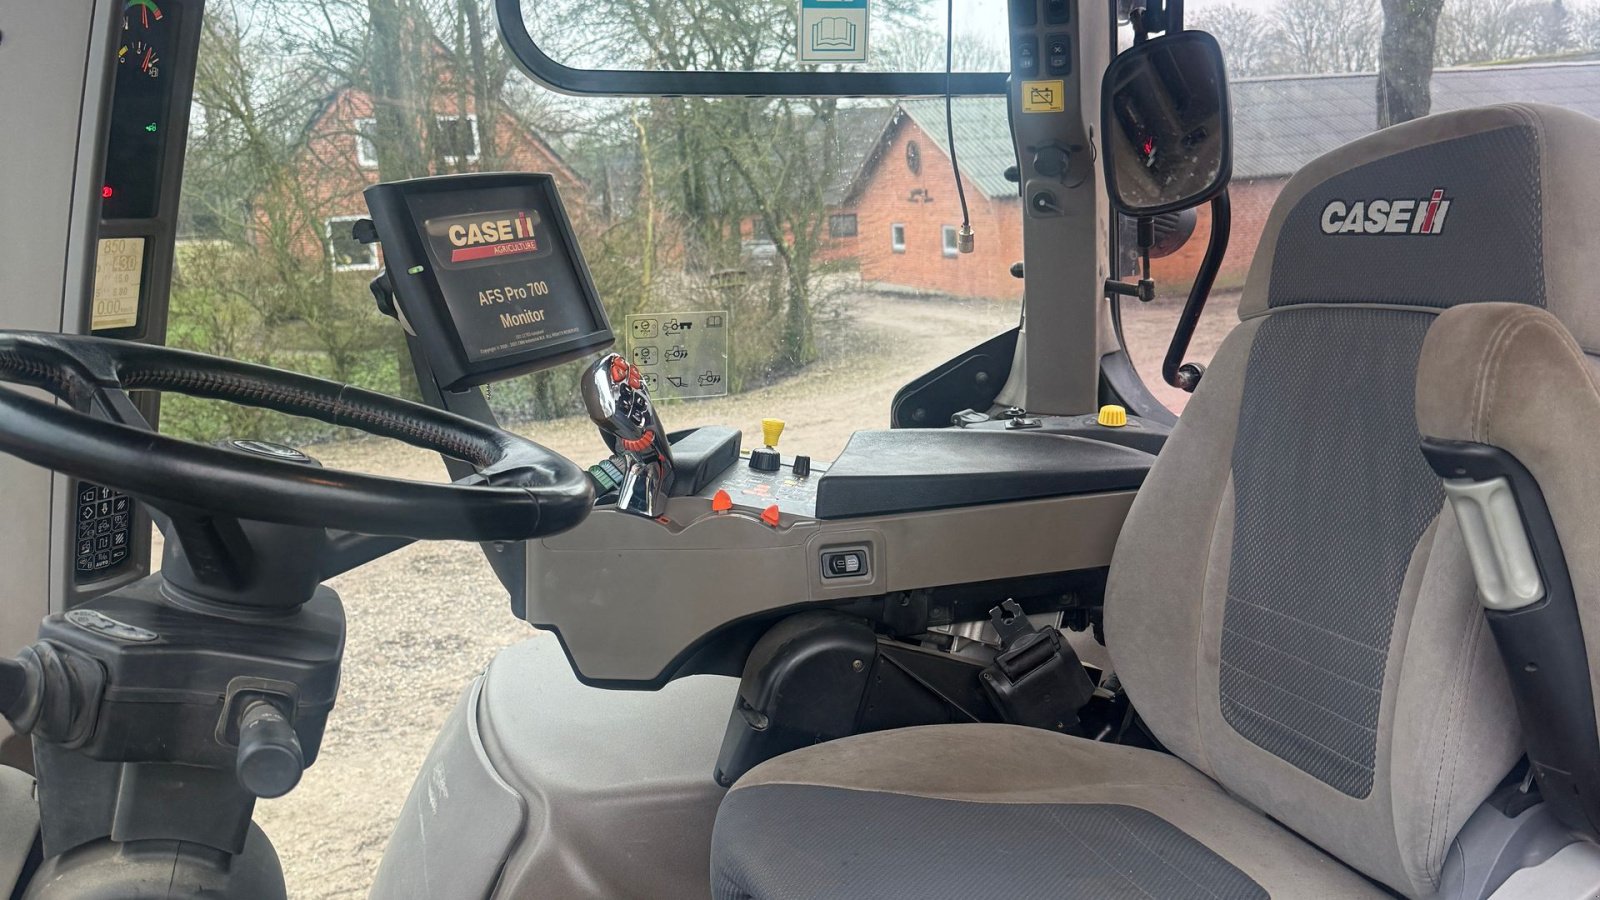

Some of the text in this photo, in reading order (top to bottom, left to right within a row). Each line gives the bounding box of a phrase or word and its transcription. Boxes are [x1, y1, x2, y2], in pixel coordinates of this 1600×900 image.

[449, 220, 513, 246] CASE
[494, 241, 537, 255] AGRICULTURE
[478, 280, 549, 306] AFS Pro 700
[500, 309, 545, 328] Monitor
